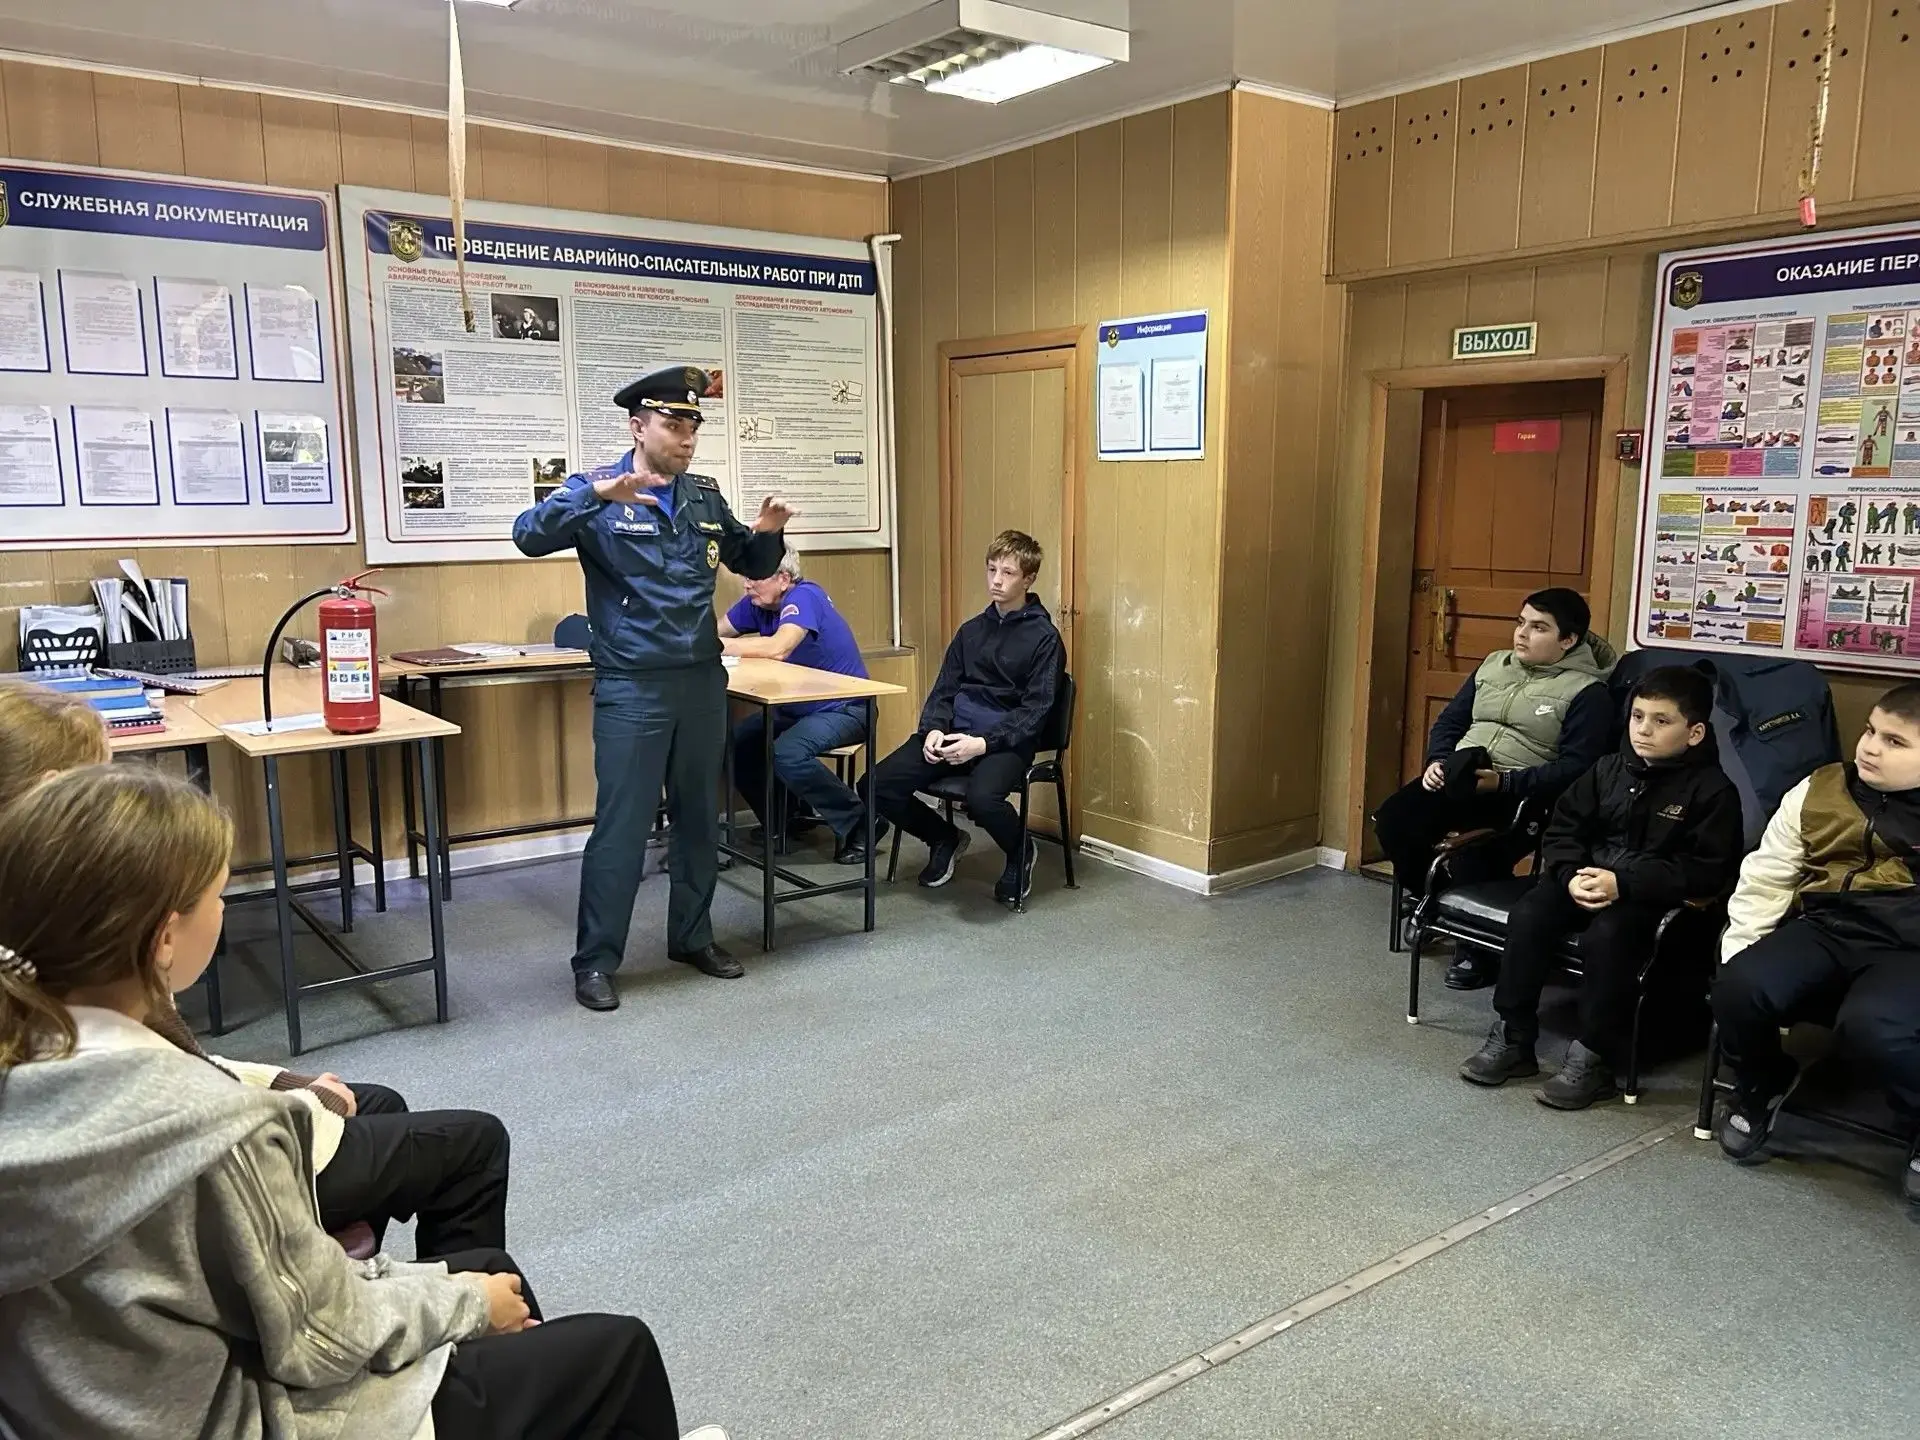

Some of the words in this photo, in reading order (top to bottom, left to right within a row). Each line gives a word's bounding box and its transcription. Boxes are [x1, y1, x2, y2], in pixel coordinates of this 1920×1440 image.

[19, 191, 149, 217] СЛУЖЕБНАЯ
[154, 204, 309, 232] ДОКУМЕНТАЦИЯ
[387, 265, 428, 276] ОСНОВНЫЕ
[434, 235, 550, 261] ПРОВЕДЕНИЕ
[553, 247, 760, 280] АВАРИЙНО-СПАСАТЕЛЬНЫХ
[763, 266, 806, 283] РАБОТ
[809, 270, 835, 286] ПРИ
[838, 273, 863, 289] ДТП
[1776, 258, 1875, 282] ОКАЗАНИЕ
[1880, 253, 1920, 272] ПЕР
[387, 273, 481, 287] АВАРИЙНО-СПАСАТЕНЫХ
[1136, 323, 1172, 335] Информация
[1462, 330, 1528, 352] ВЫХОД
[1517, 432, 1537, 441] Гараж
